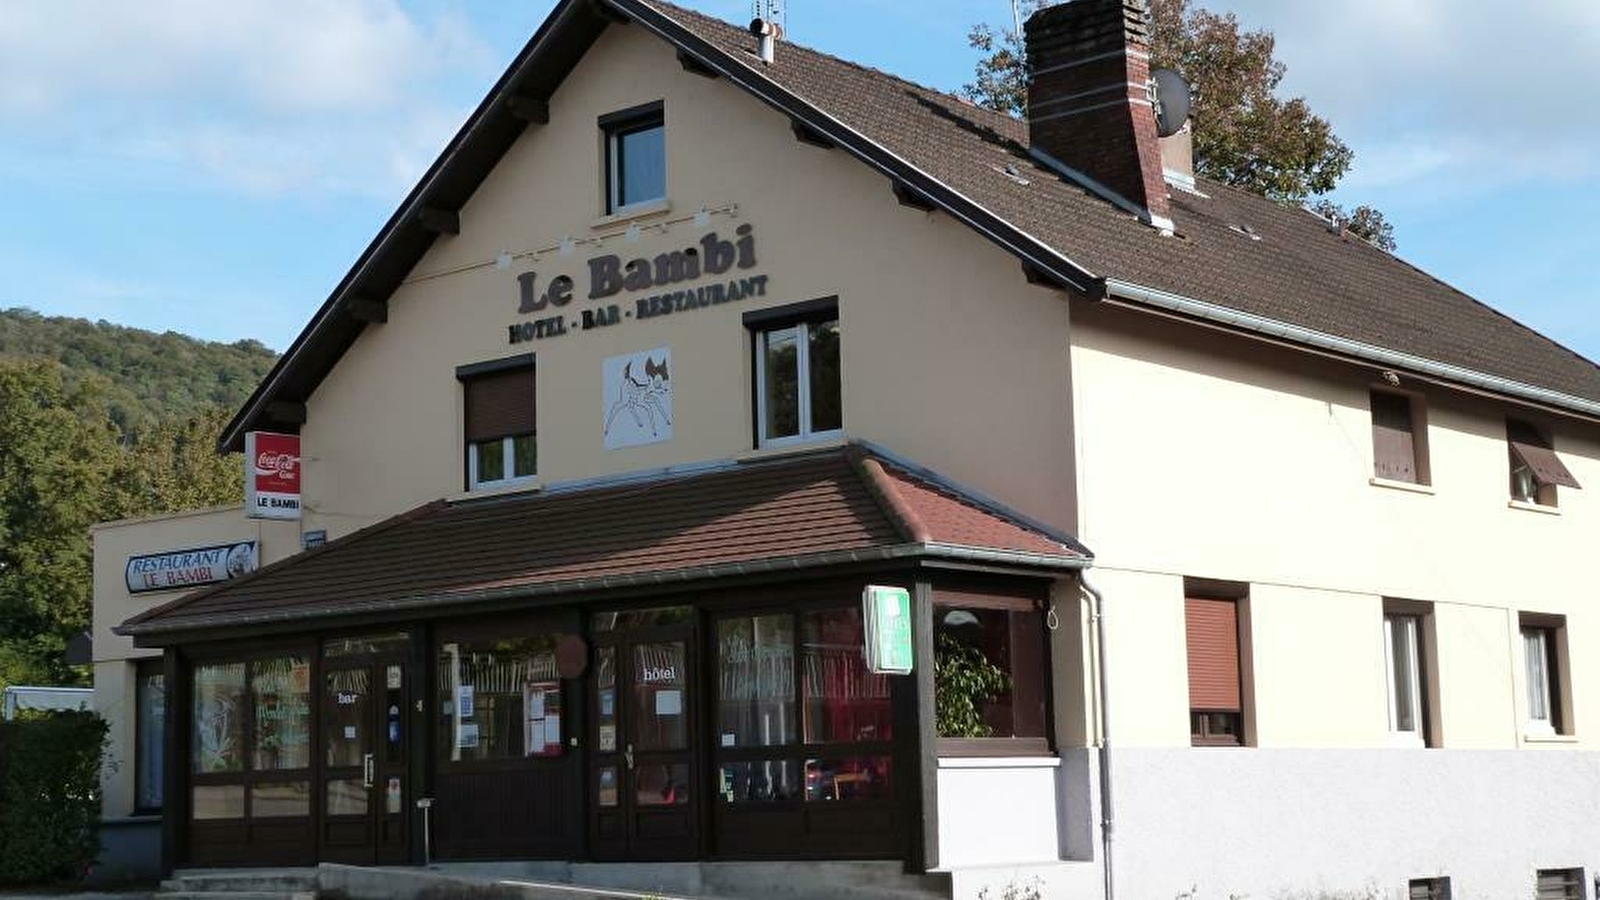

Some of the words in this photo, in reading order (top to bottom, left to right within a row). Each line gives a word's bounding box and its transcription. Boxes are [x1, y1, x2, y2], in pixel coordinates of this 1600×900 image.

[517, 271, 575, 315] Le
[587, 223, 757, 300] Bambi
[508, 315, 567, 344] HOTEL
[581, 305, 621, 330] BAR
[635, 274, 769, 319] RESTAURANT
[257, 497, 268, 508] LE
[271, 497, 300, 509] BAMBI
[132, 551, 222, 574] RESTAURANT
[143, 572, 160, 589] LE
[166, 566, 213, 586] BAMBI
[643, 666, 677, 681] hôtel
[338, 692, 358, 704] bar
